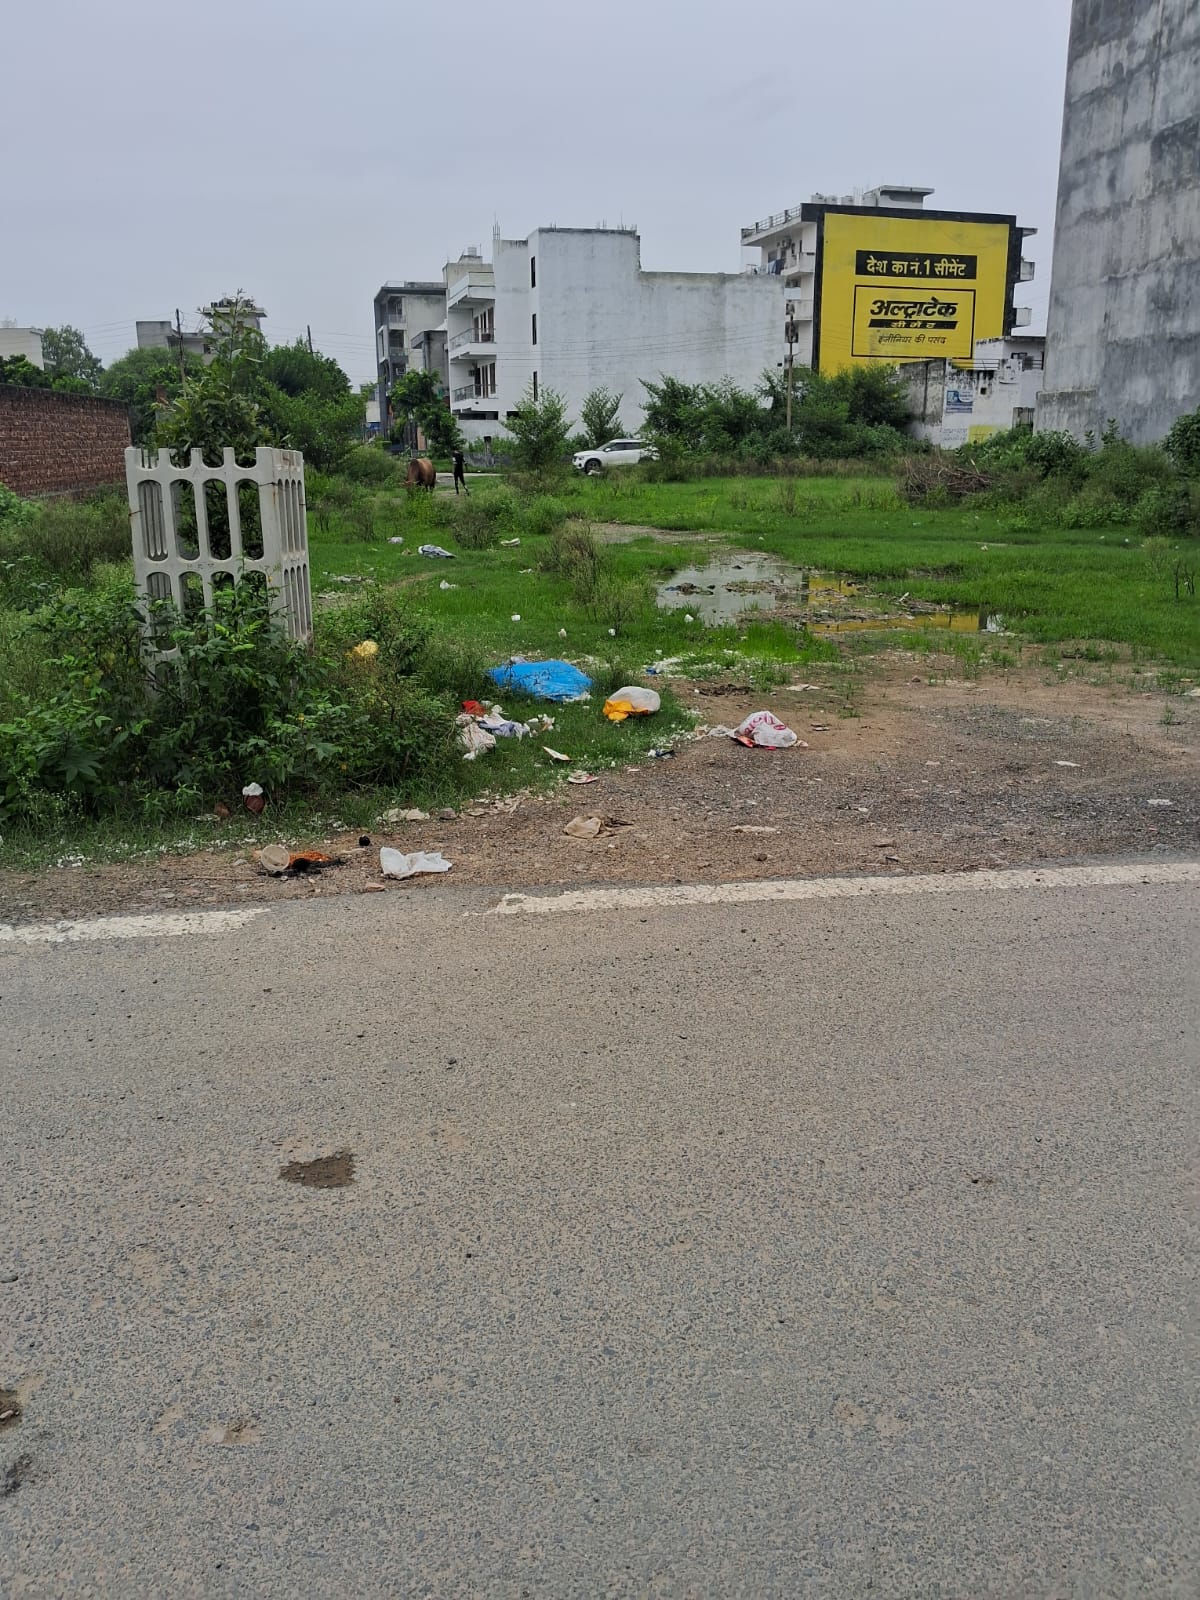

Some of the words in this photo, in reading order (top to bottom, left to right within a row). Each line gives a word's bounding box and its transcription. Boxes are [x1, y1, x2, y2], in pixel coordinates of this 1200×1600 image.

[866, 256, 888, 273] देश
[891, 260, 908, 274] का
[934, 258, 967, 276] सीमेंट
[870, 296, 959, 319] अल्ट्राटेक
[914, 333, 926, 344] की
